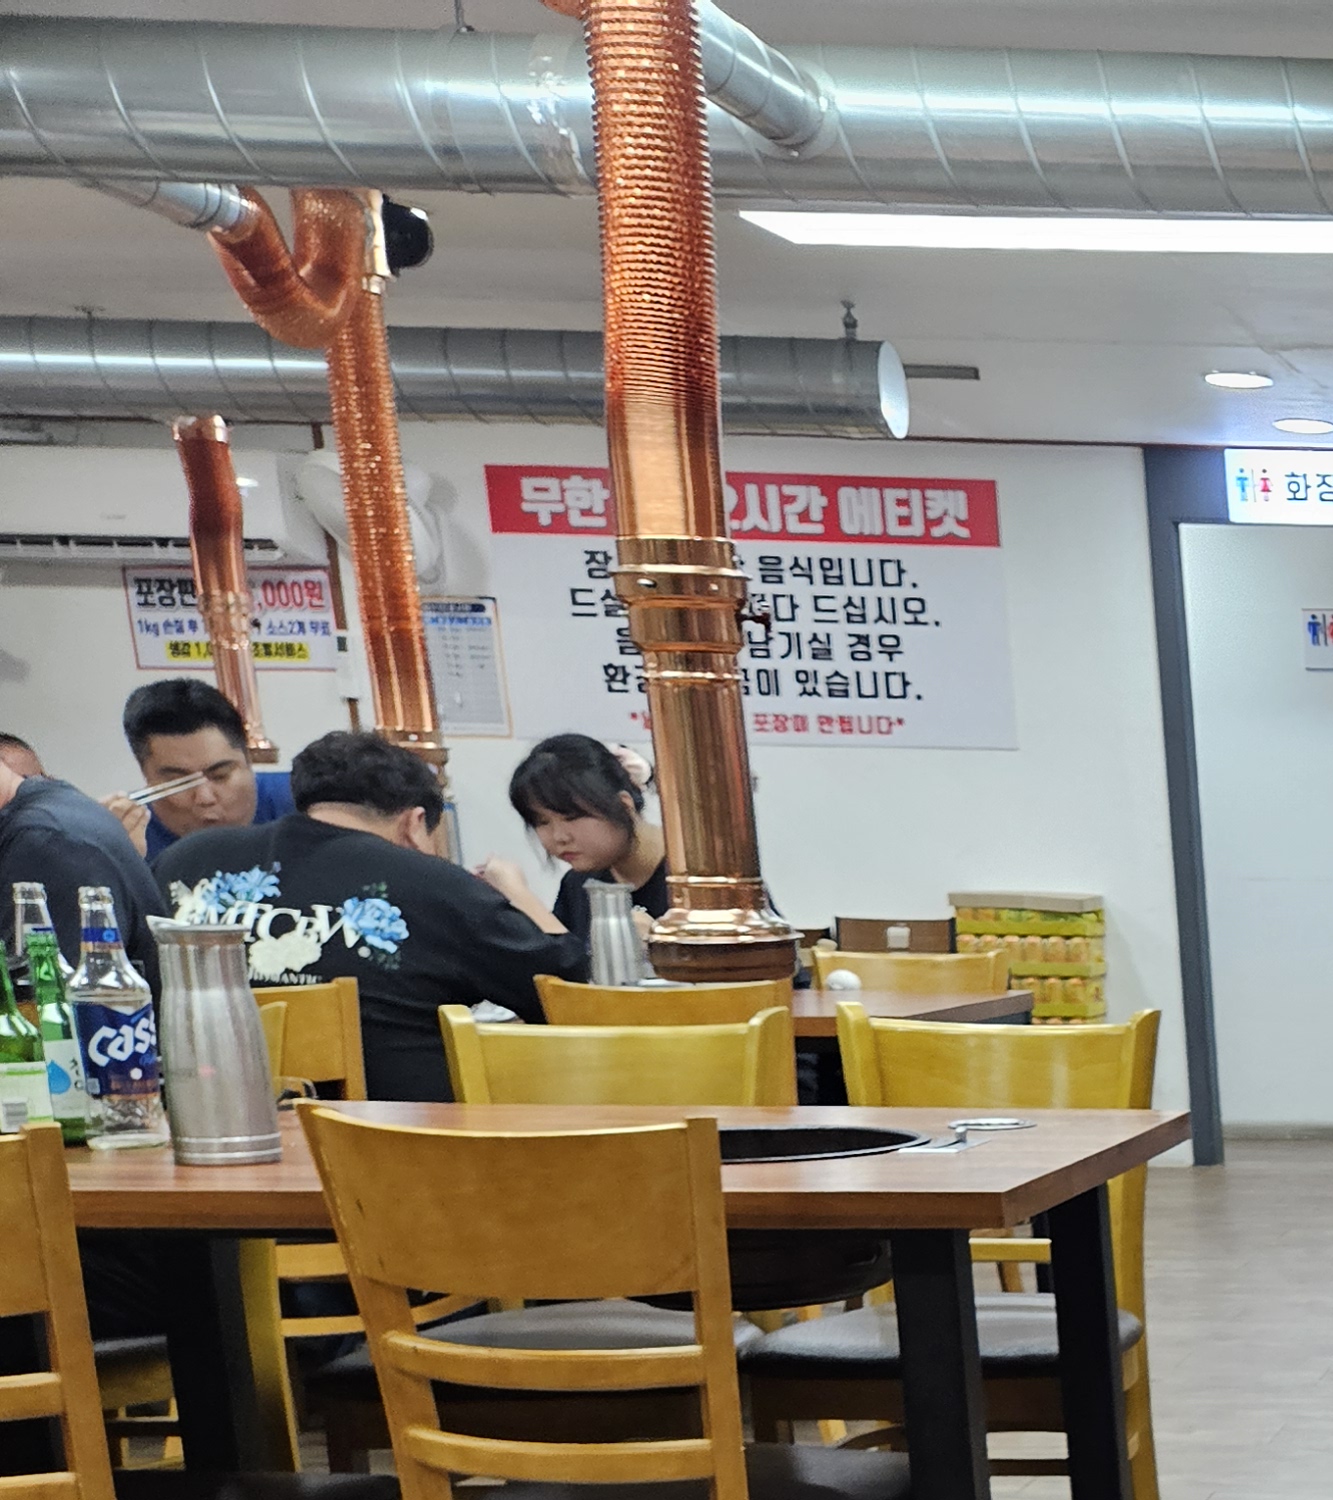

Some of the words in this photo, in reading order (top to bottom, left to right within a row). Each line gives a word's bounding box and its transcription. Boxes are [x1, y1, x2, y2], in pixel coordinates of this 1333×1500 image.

[520, 475, 610, 528] 무한
[837, 485, 971, 539] 에티켓
[758, 555, 918, 588] 음식입니다.
[813, 595, 941, 627] 드십시오.
[847, 632, 904, 662] 경우
[795, 668, 922, 700] 있습니다.
